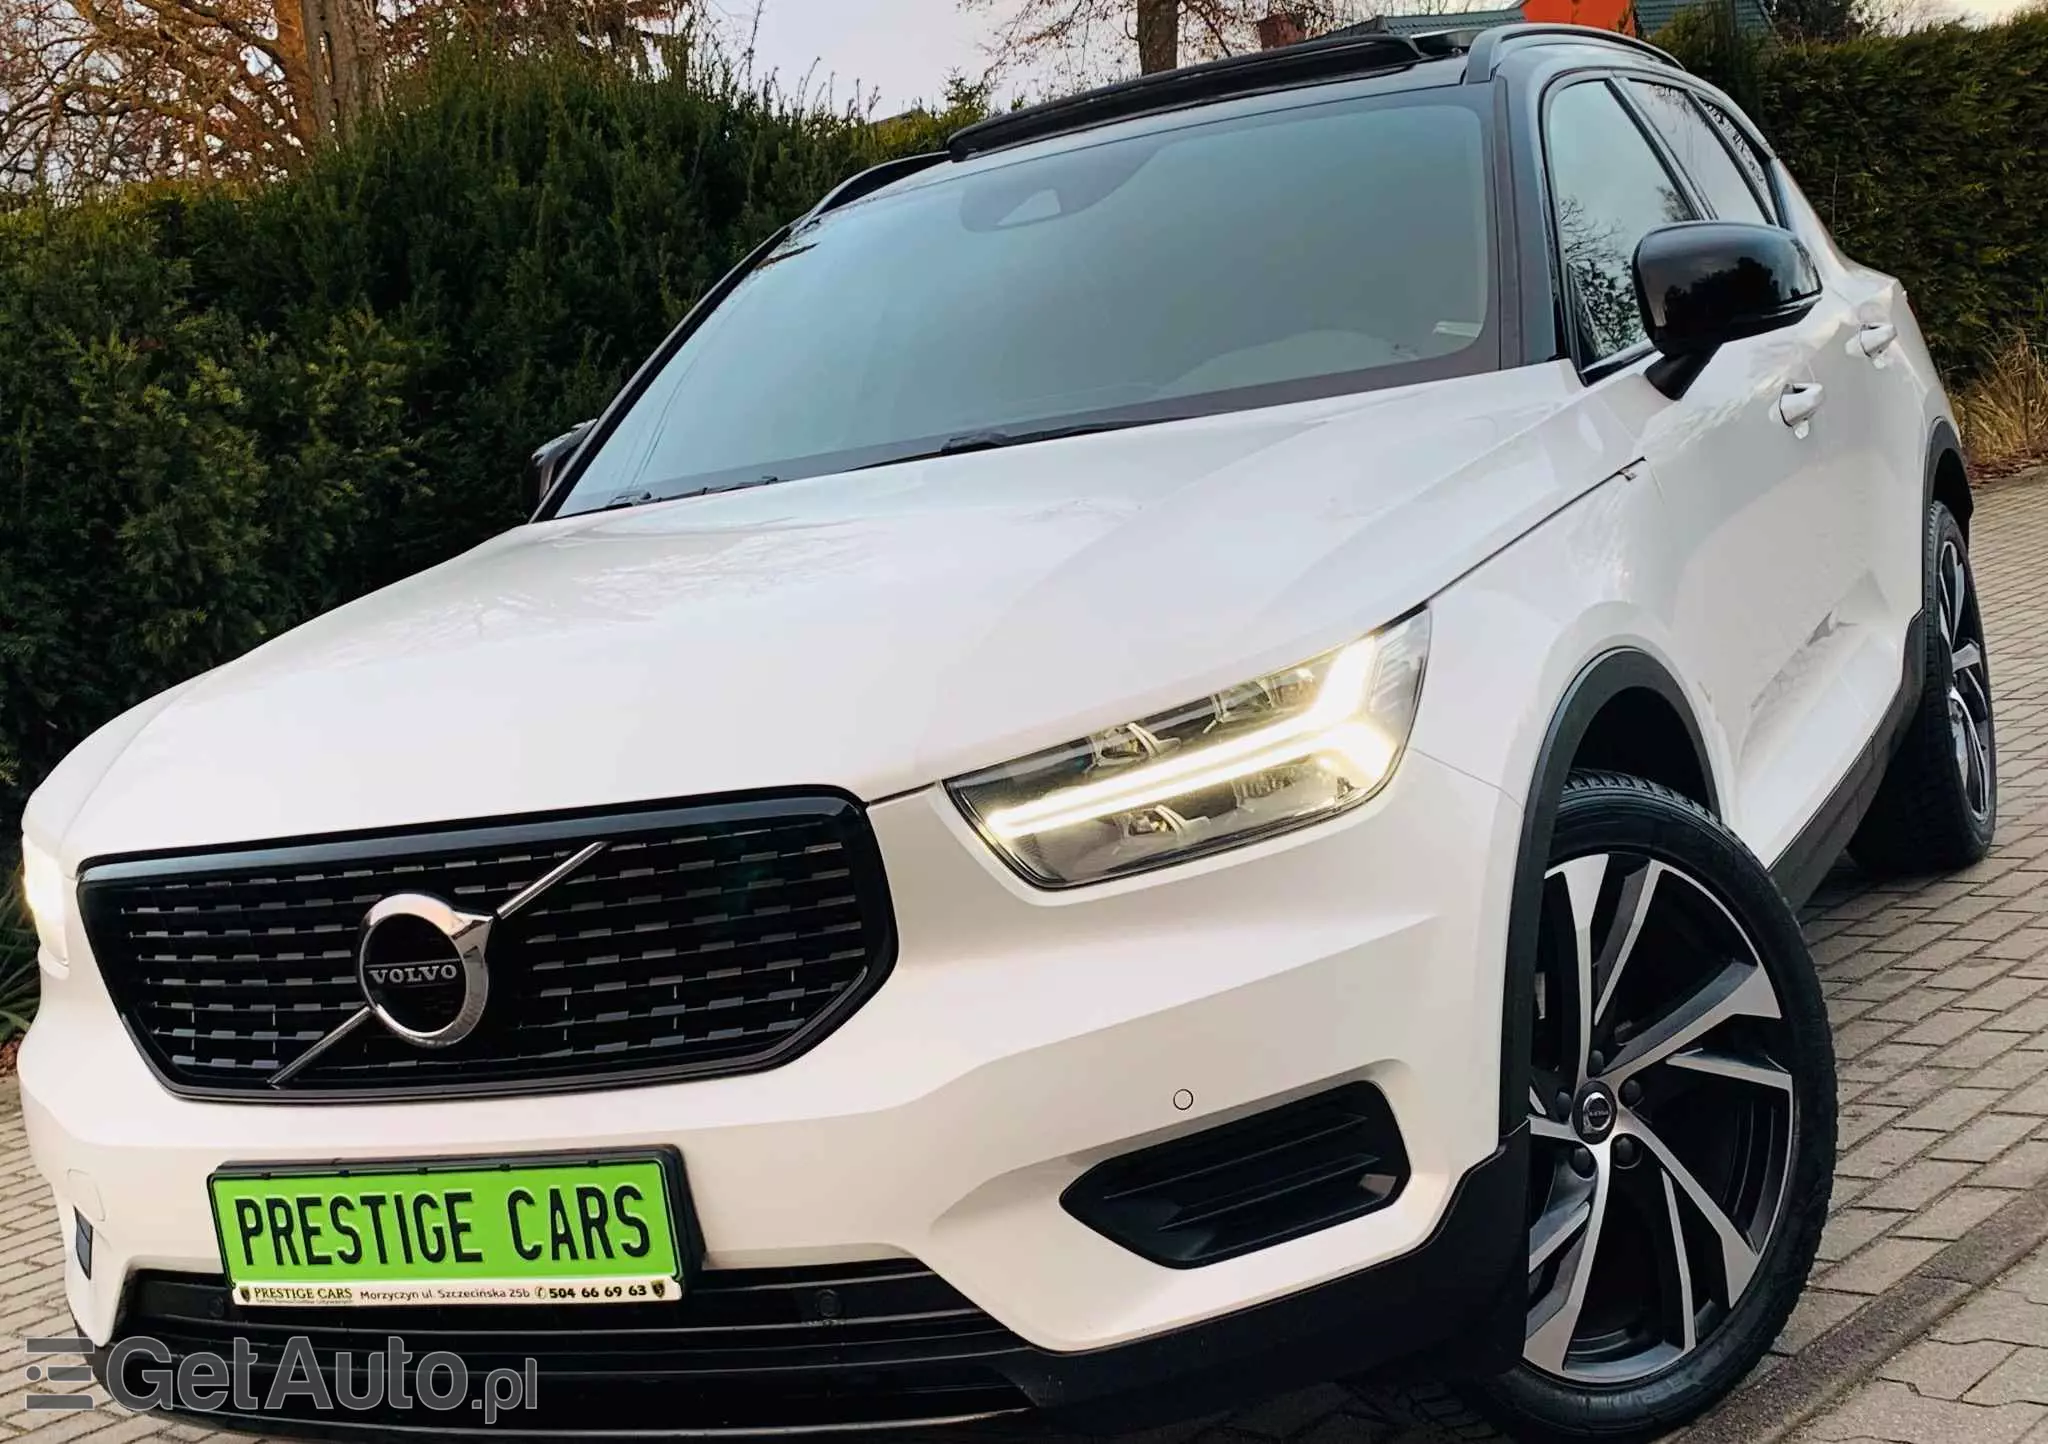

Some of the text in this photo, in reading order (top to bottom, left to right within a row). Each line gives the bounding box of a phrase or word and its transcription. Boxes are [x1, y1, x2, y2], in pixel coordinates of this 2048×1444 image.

[368, 964, 458, 984] VOLVO
[234, 1184, 652, 1267] PRESTIGE CARS
[254, 1287, 353, 1299] PRESTIGE CARS
[360, 1290, 419, 1301] Morzyczyn
[509, 1287, 531, 1298] 25b
[549, 1286, 577, 1299] 504
[581, 1286, 600, 1298] 66
[604, 1285, 623, 1298] 69
[628, 1284, 648, 1297] 63
